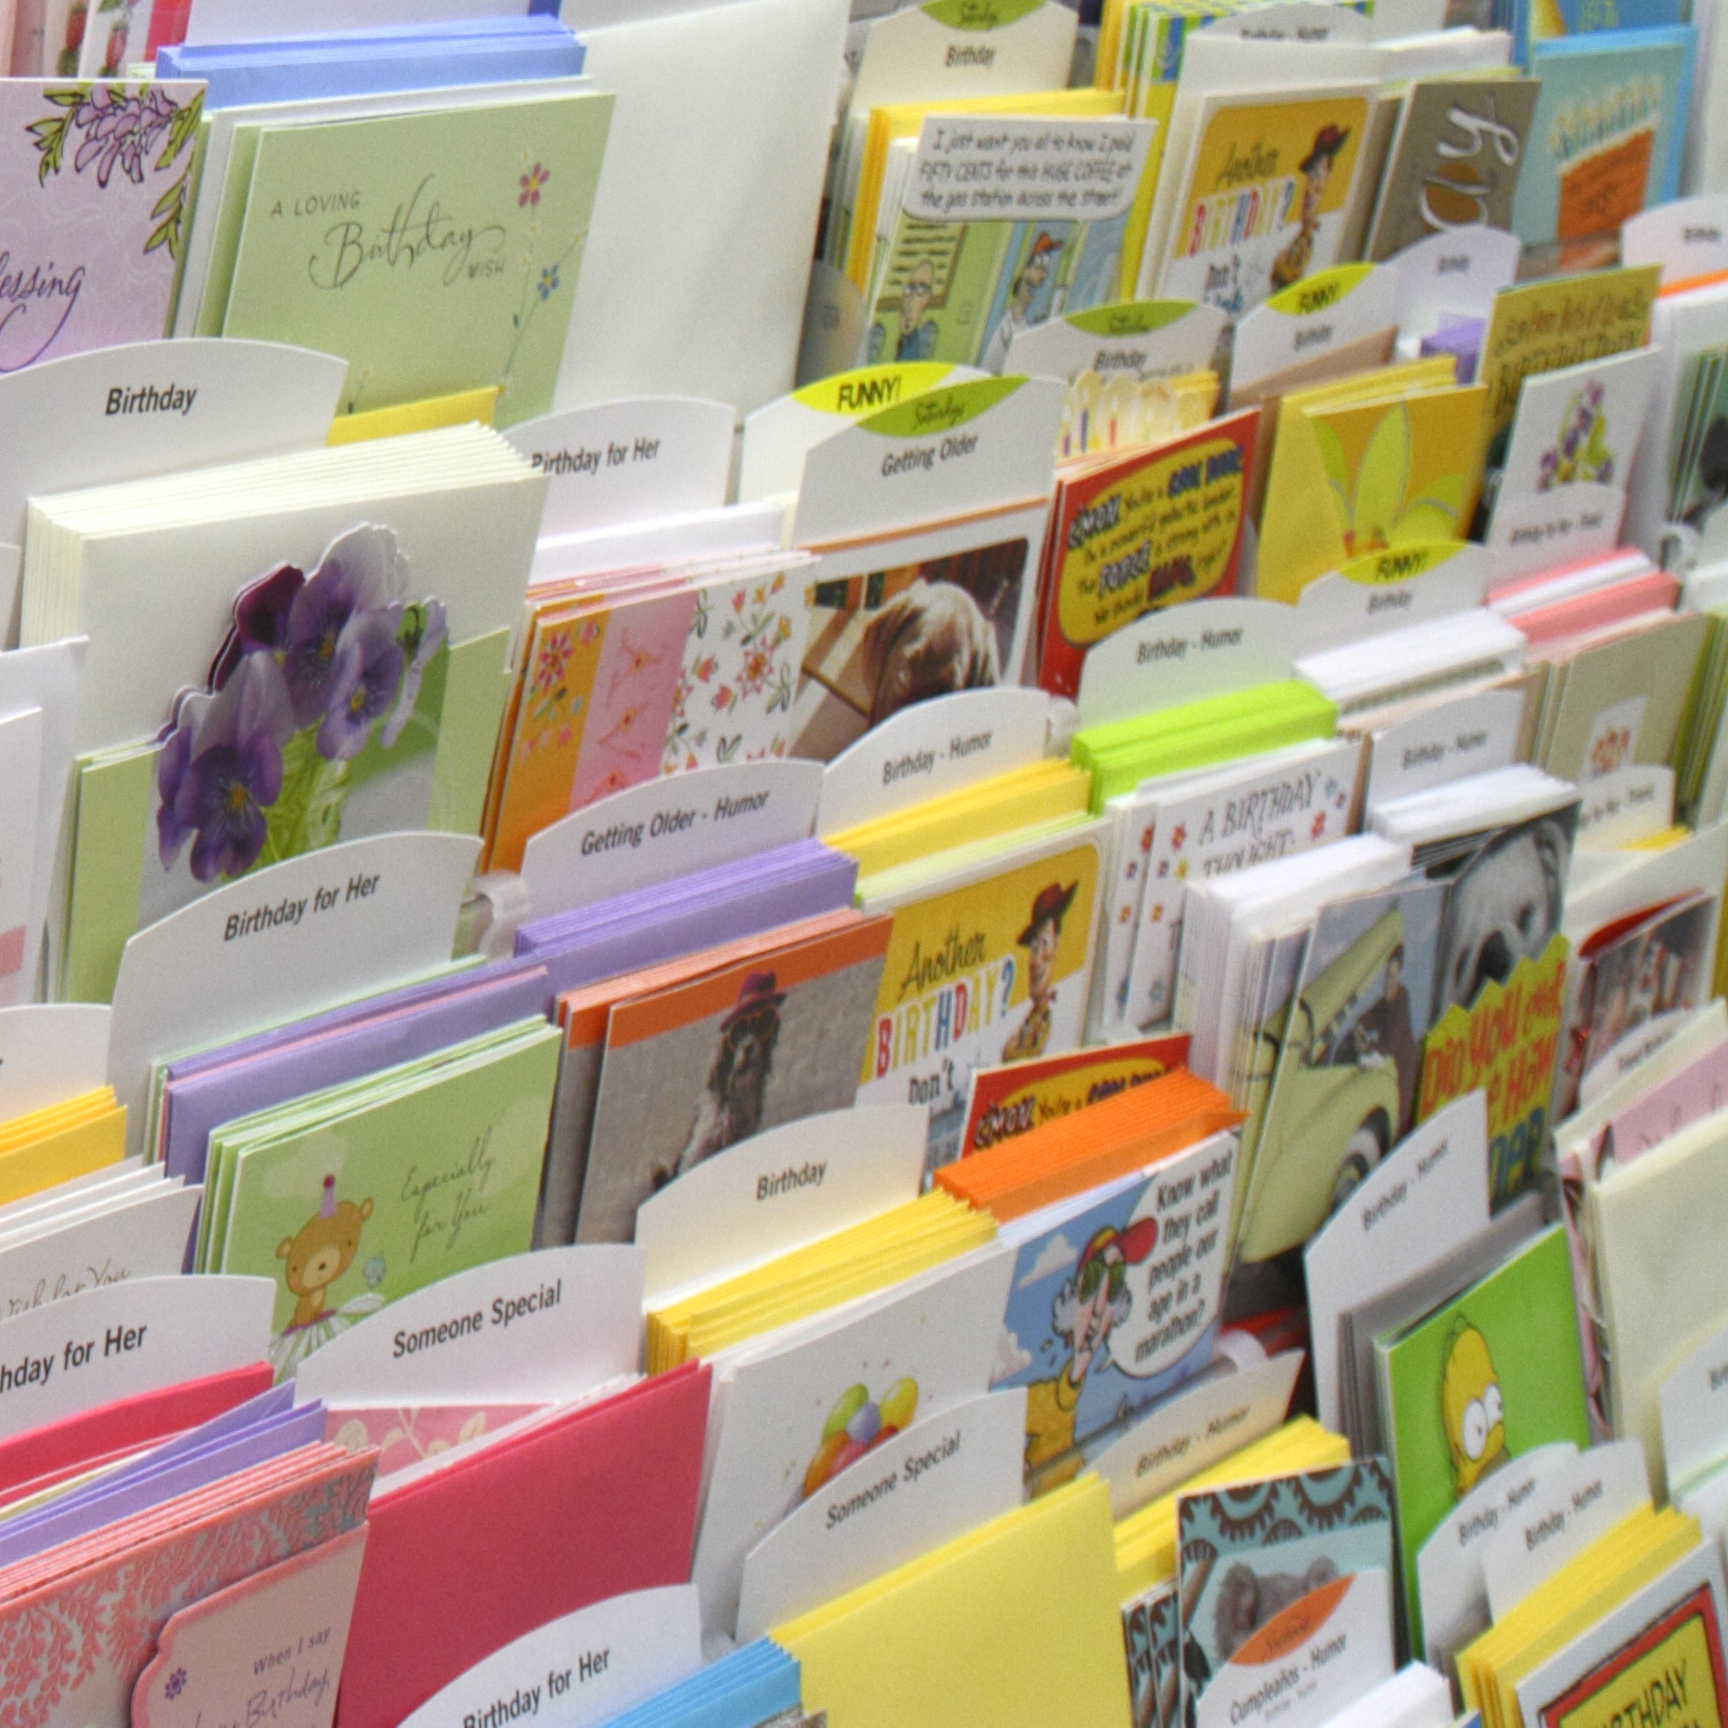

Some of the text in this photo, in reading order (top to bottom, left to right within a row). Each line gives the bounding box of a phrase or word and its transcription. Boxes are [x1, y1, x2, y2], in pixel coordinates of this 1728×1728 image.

[105, 383, 198, 416] Birthday
[881, 432, 979, 477] Getting Older
[882, 731, 993, 785] Birthday Humor
[580, 790, 769, 856] Getting Older Humor
[757, 1160, 827, 1201] Birthday
[392, 1279, 563, 1359] Someone Special
[63, 1339, 96, 1370] for
[103, 1322, 148, 1358] Her
[825, 1429, 961, 1529] Someone Special
